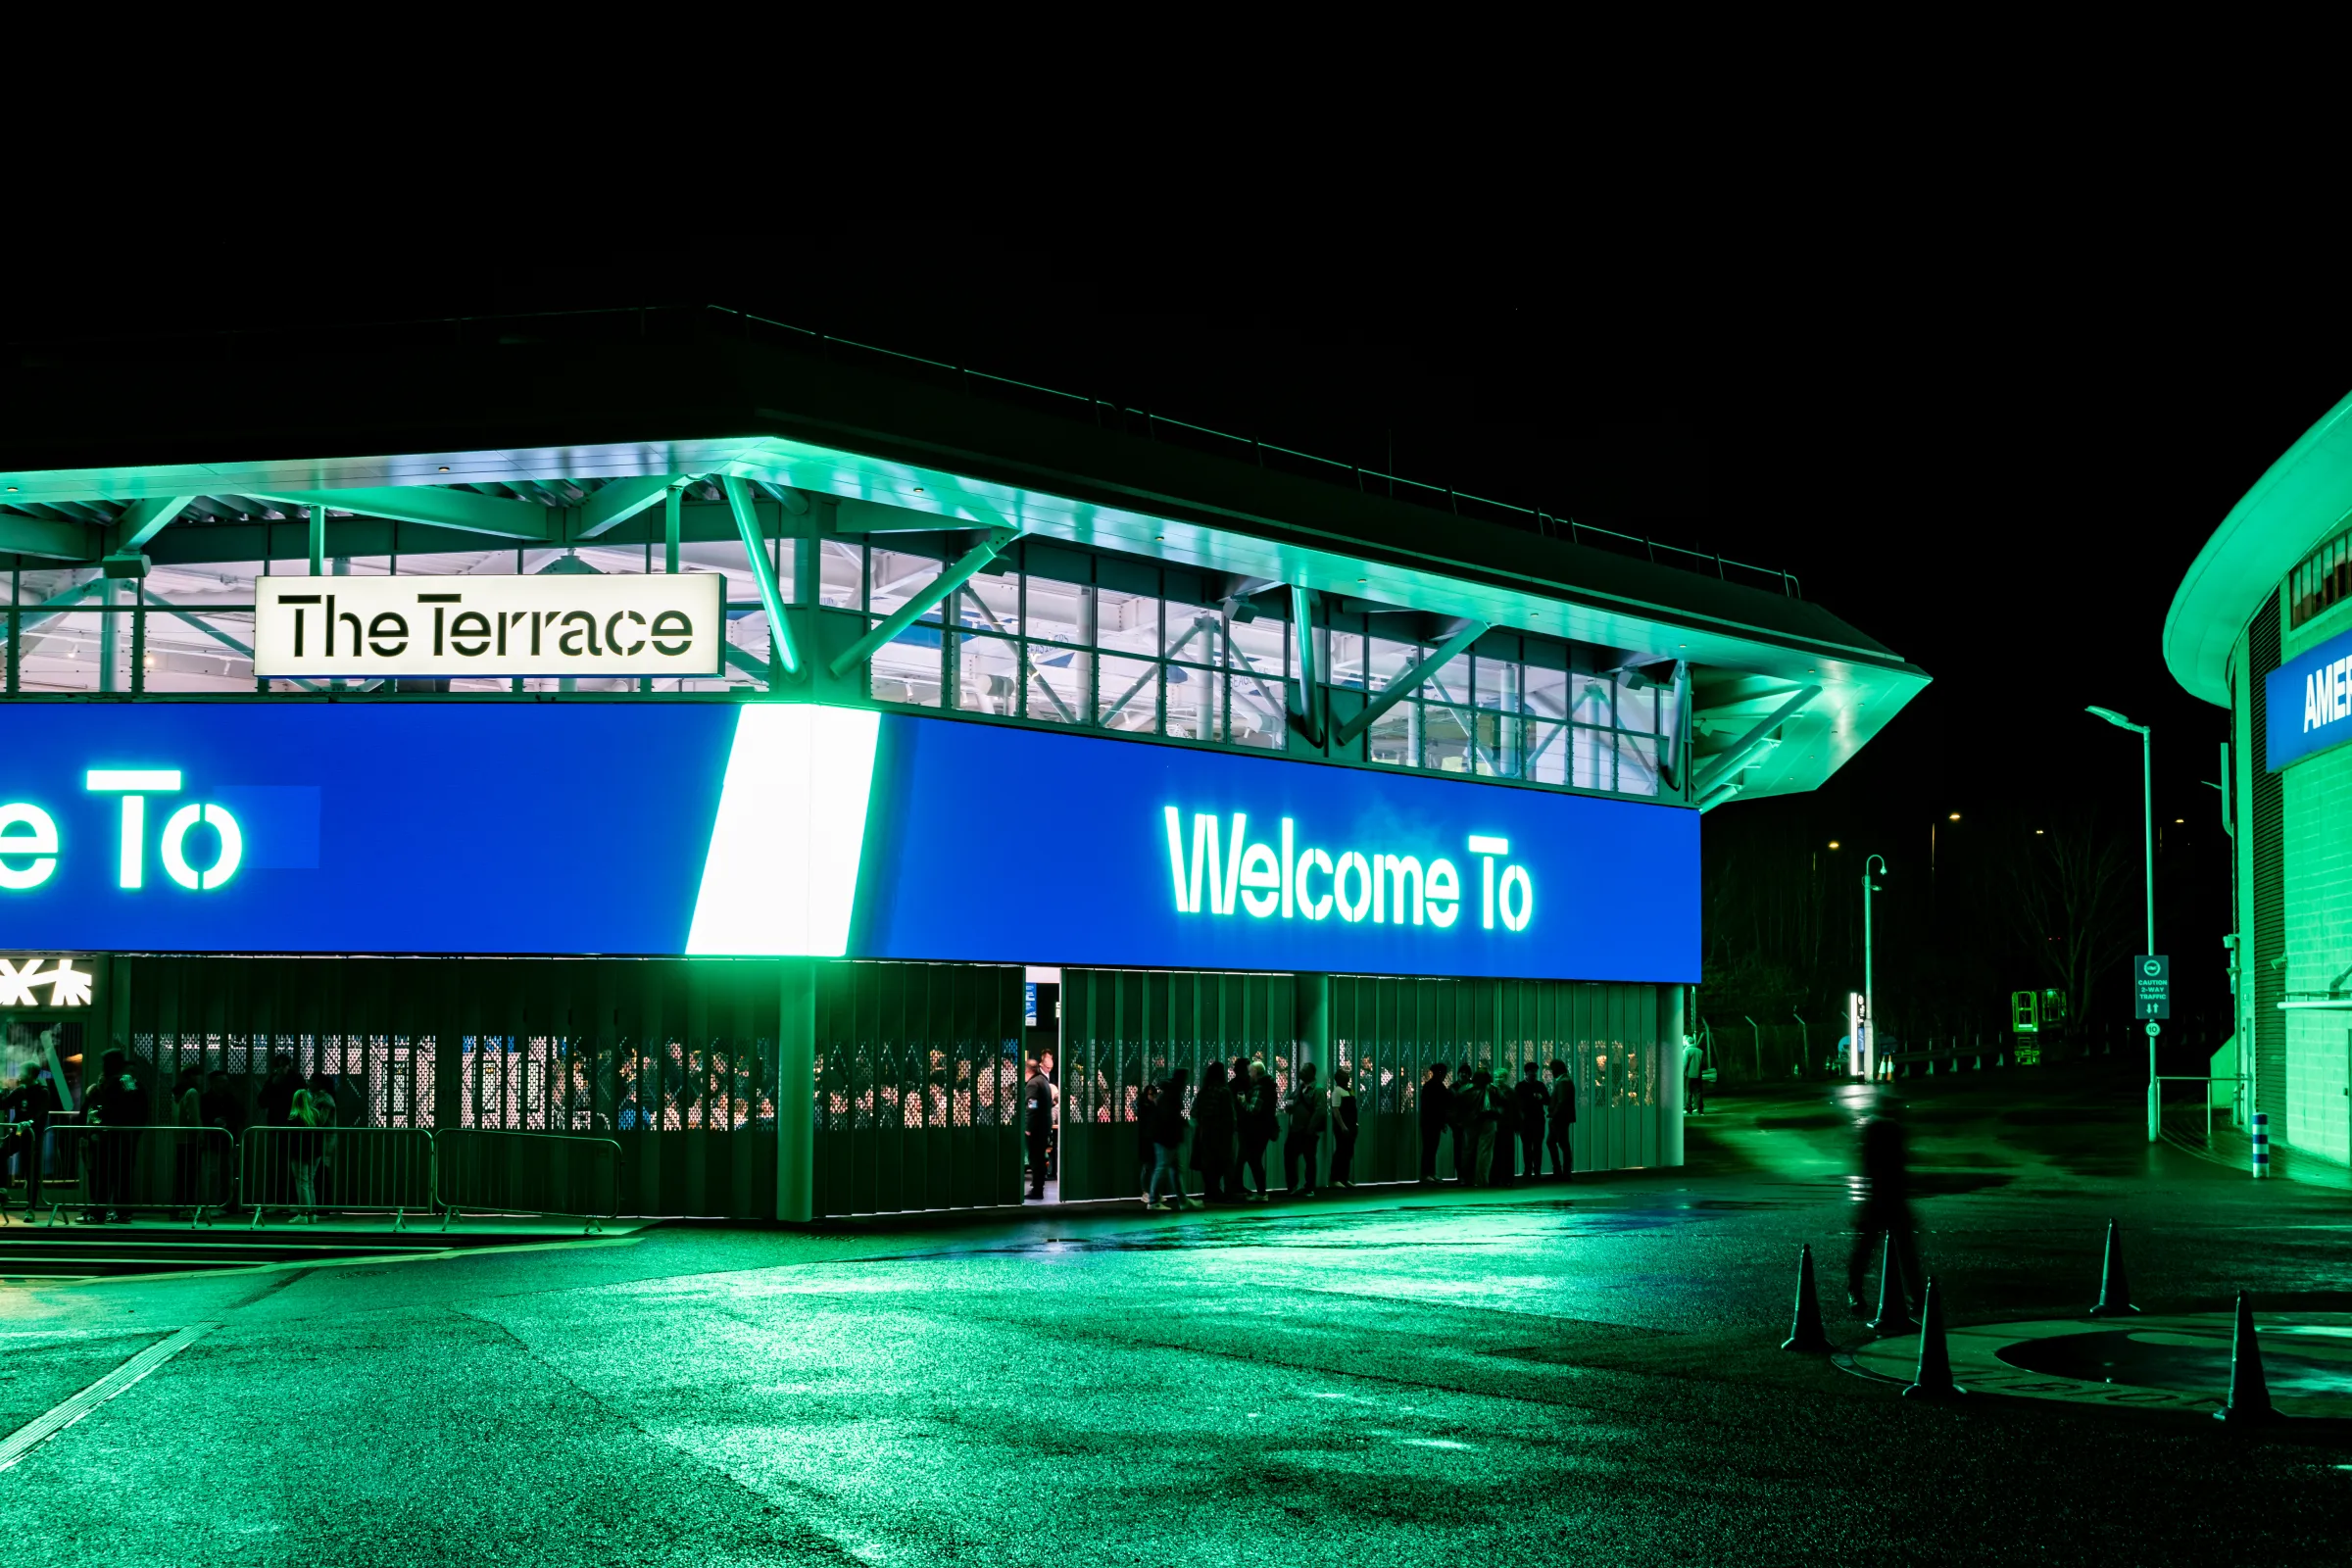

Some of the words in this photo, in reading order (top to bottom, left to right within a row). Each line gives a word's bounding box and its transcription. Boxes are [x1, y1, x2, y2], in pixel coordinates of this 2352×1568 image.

[278, 595, 408, 657] The
[418, 594, 692, 656] Terrace
[87, 770, 242, 889] To
[1165, 807, 1459, 927] Welcome
[1469, 836, 1532, 931] To
